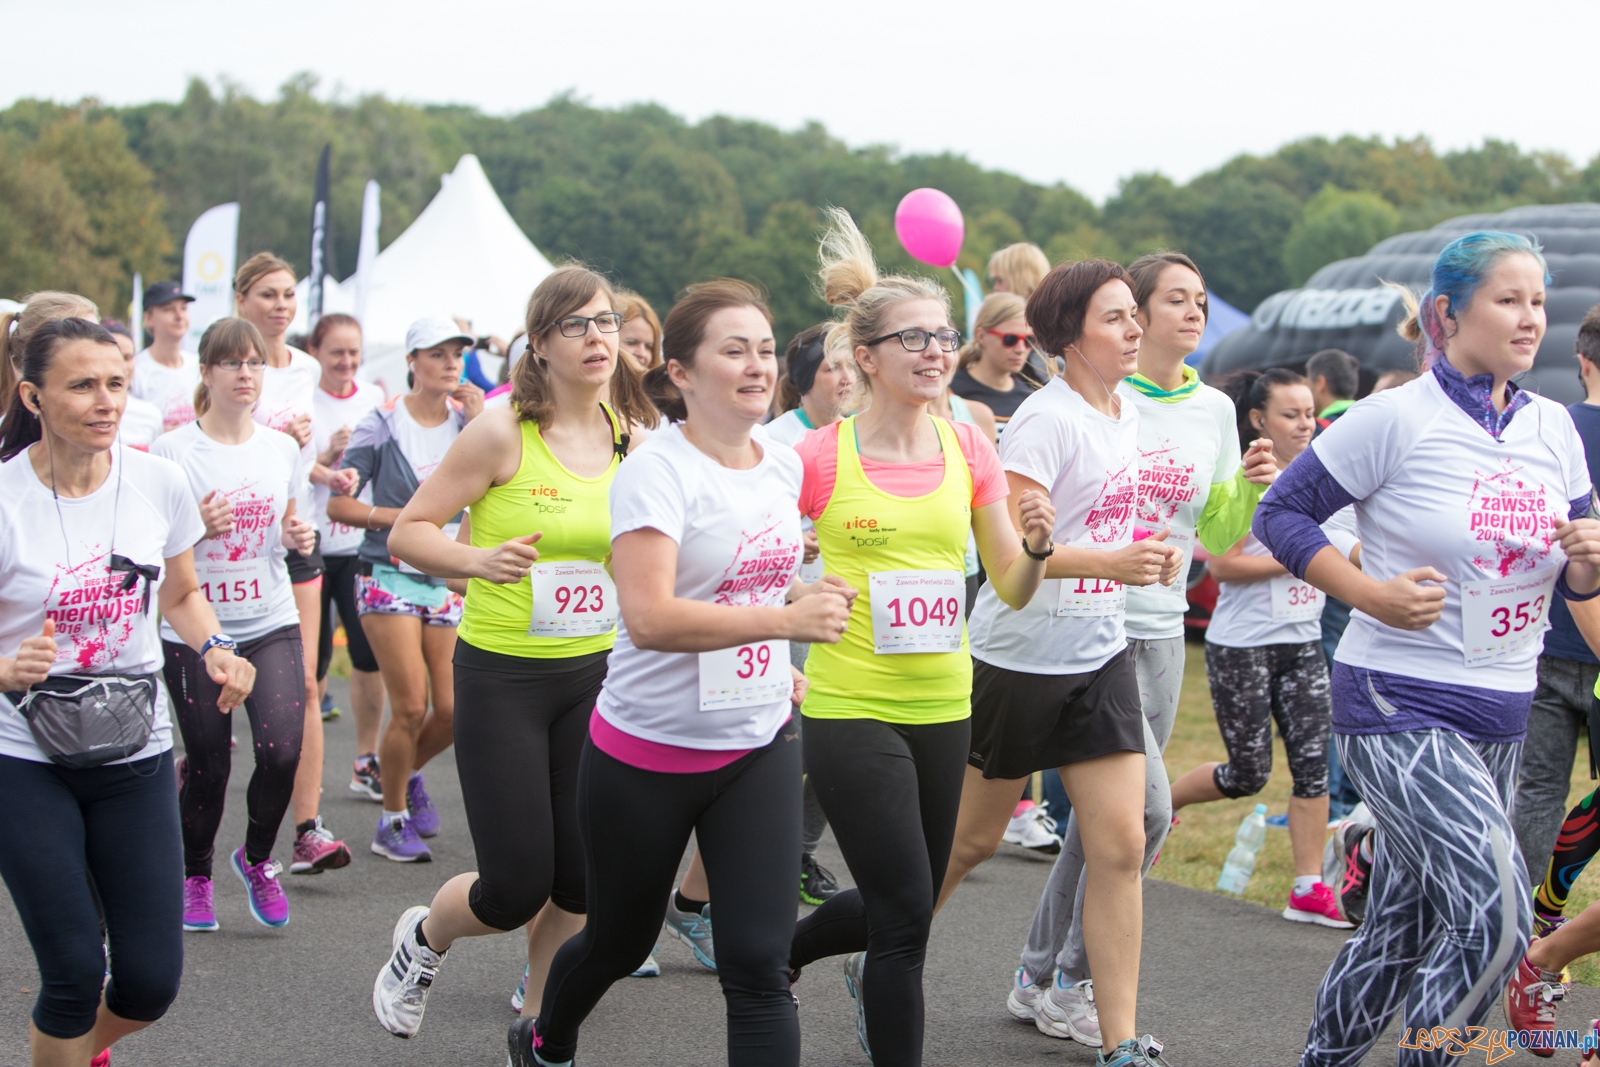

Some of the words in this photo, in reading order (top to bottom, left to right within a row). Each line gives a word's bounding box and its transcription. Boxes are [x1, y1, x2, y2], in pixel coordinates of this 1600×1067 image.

[1481, 497, 1546, 512] zawsze
[1476, 529, 1505, 541] 2016
[737, 555, 796, 576] zawsze
[84, 578, 100, 588] BIEG
[200, 578, 262, 603] 1151
[555, 585, 604, 614] 923
[1288, 585, 1317, 606] 334
[887, 597, 959, 627] 1049
[1491, 594, 1545, 637] 353
[736, 644, 771, 679] 39
